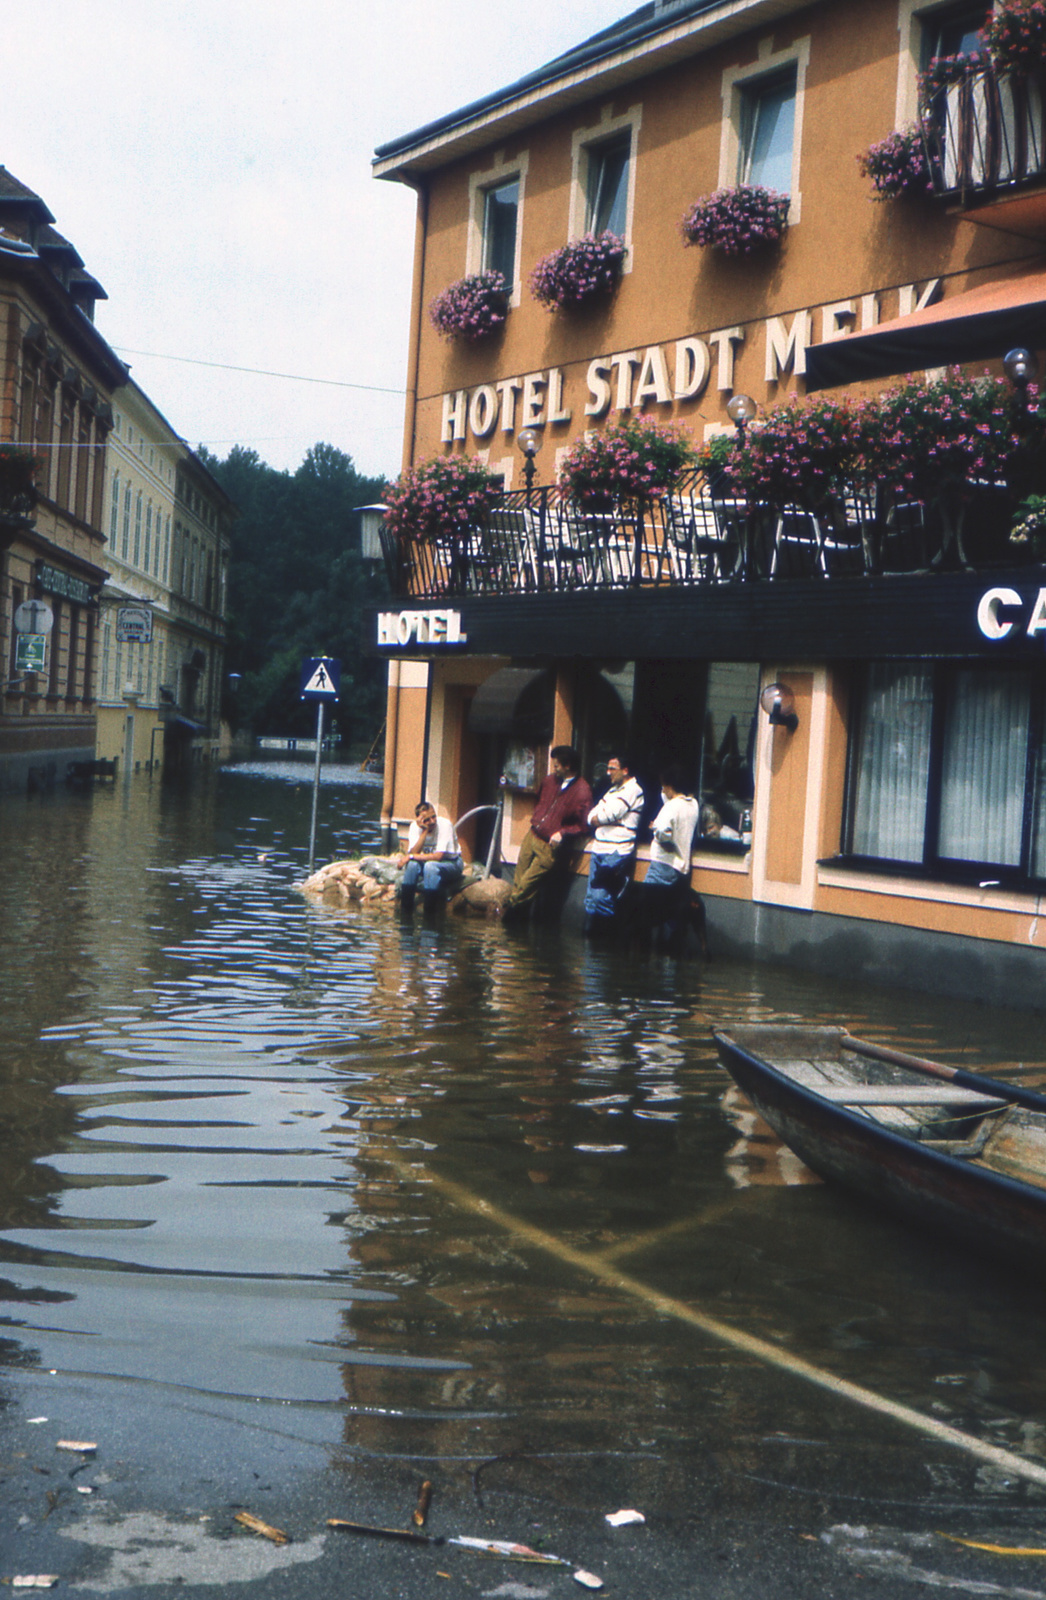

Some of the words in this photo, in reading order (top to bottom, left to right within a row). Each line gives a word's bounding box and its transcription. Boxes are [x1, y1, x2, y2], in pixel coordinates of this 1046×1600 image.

[441, 367, 571, 442] HOTEL
[584, 326, 744, 417] STADT
[377, 609, 468, 646] HOTEL
